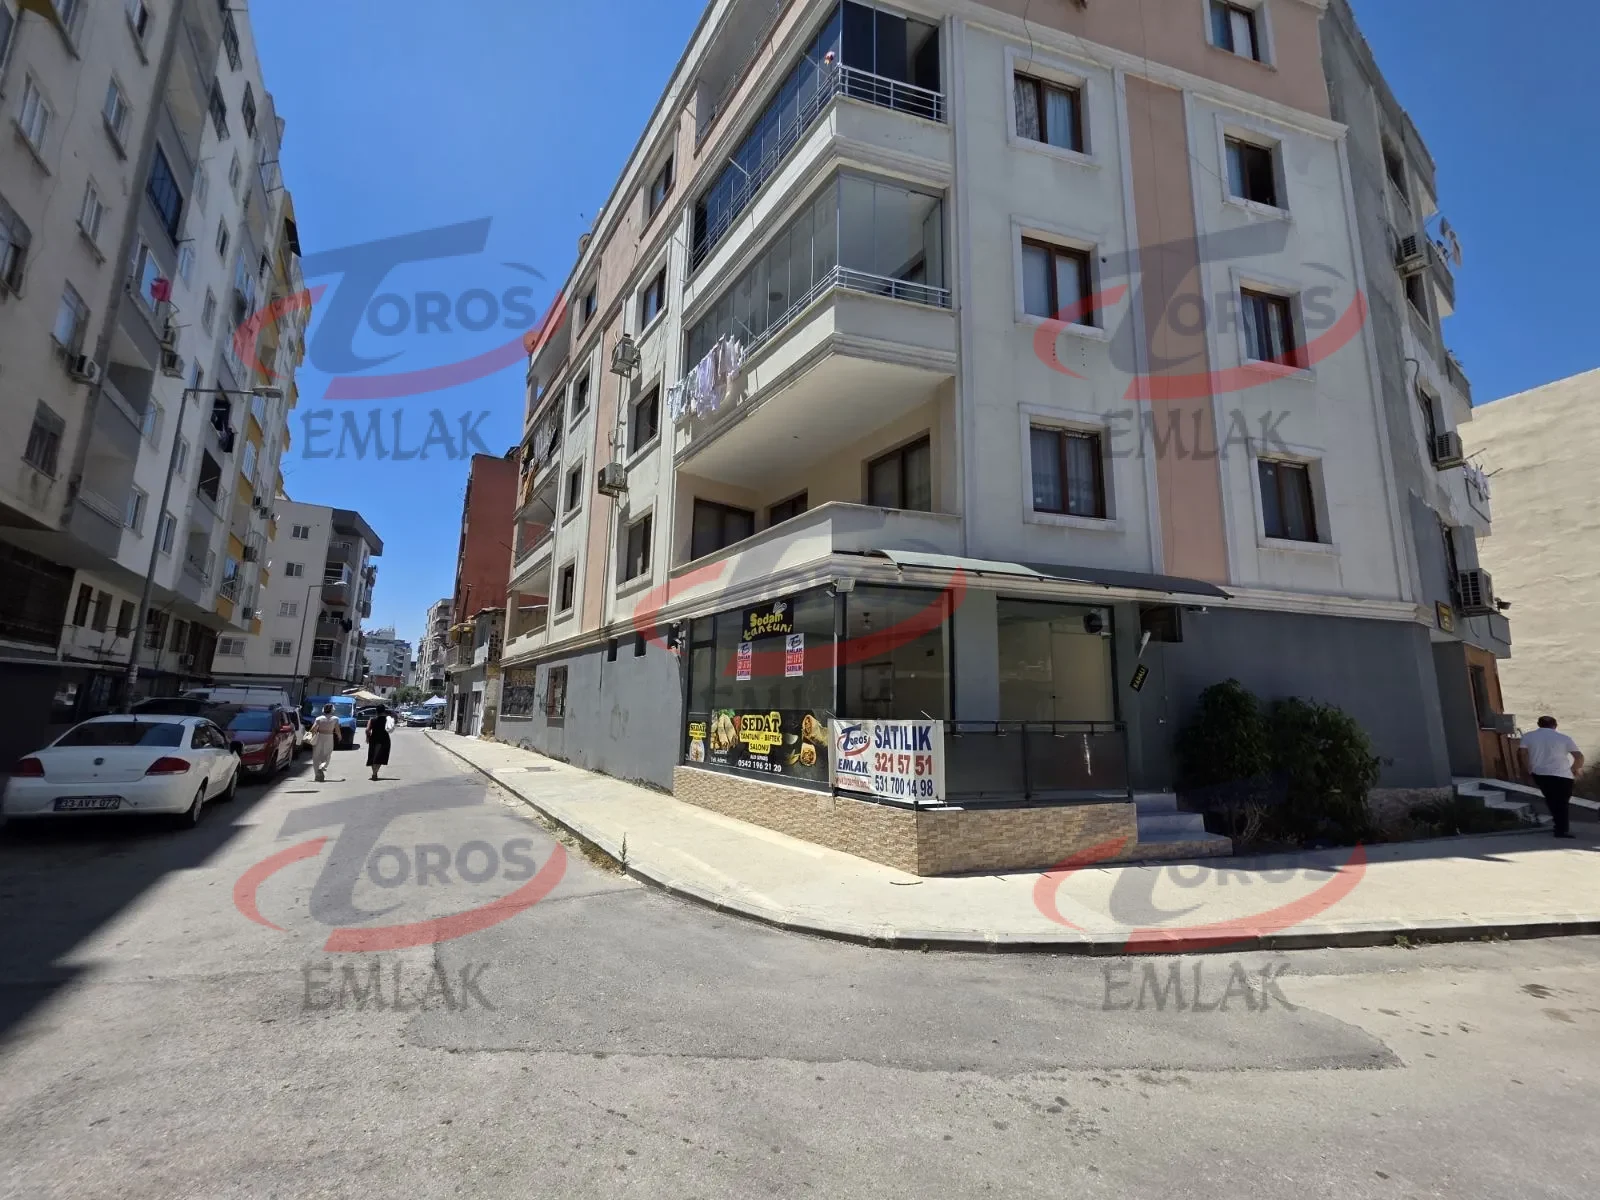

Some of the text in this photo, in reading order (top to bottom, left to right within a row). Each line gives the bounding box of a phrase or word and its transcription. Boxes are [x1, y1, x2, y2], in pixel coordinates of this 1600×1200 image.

[742, 717, 779, 732] SEDAT
[875, 725, 932, 751] SATILIK
[738, 760, 782, 772] 0542 196 21 20
[838, 759, 868, 773] EMLAK
[875, 753, 932, 775] 321 57 51
[876, 775, 888, 792] 531
[891, 777, 904, 795] 700
[907, 779, 917, 797] 14
[920, 779, 933, 797] 98
